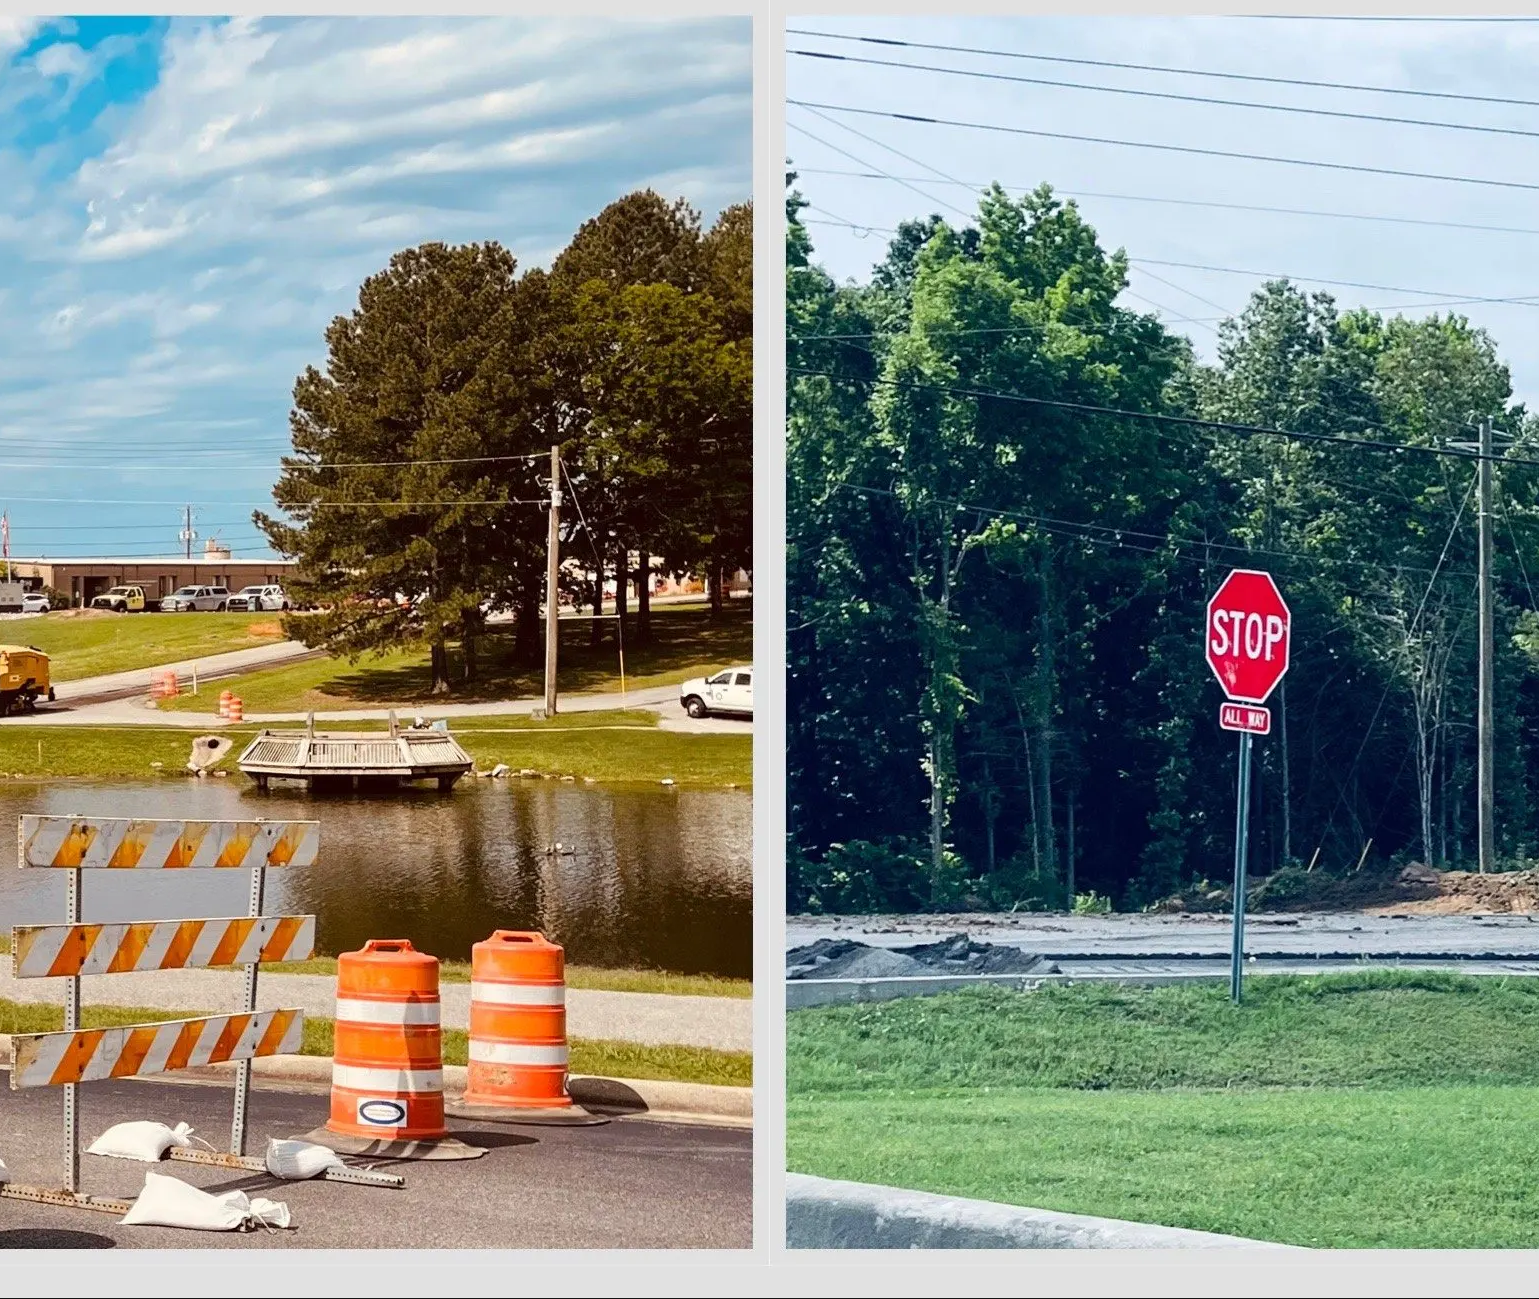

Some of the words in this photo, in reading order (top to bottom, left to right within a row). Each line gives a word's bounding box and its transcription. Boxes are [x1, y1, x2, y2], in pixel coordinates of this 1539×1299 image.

[1211, 608, 1284, 661] STOP
[1224, 708, 1243, 725] ALL
[1247, 711, 1266, 728] WAY
